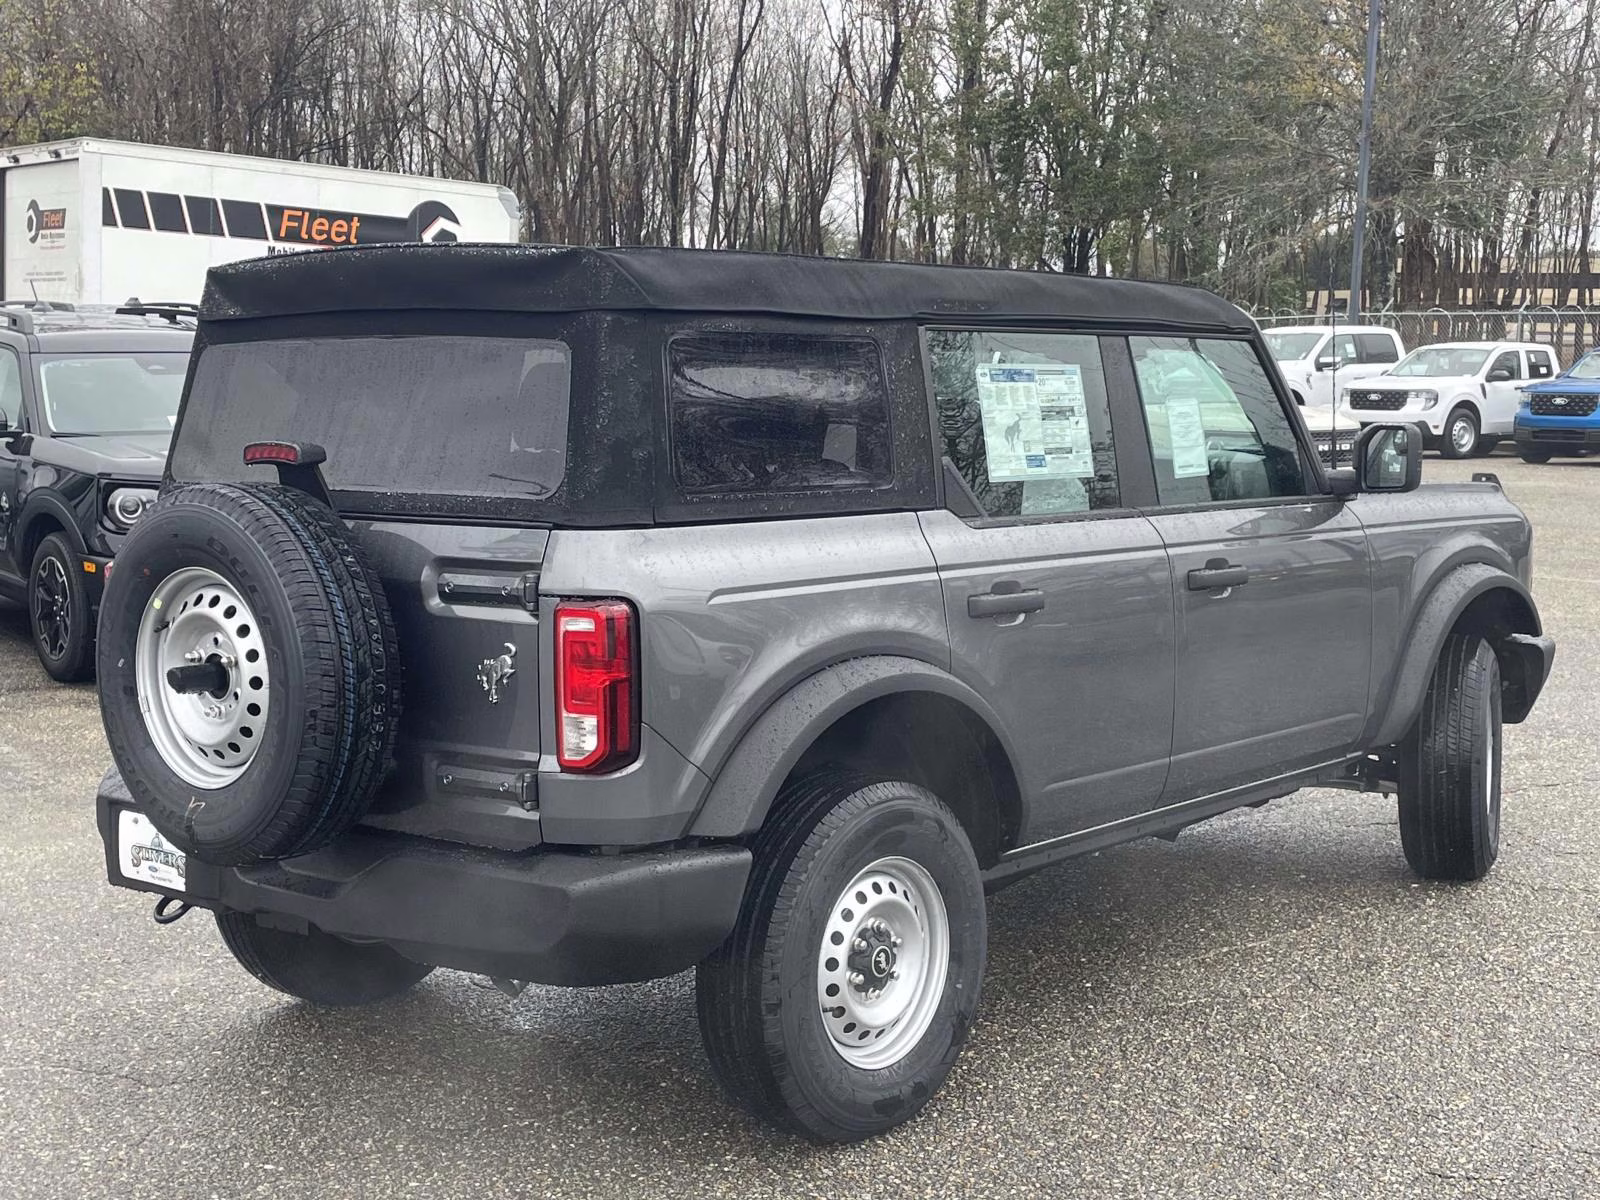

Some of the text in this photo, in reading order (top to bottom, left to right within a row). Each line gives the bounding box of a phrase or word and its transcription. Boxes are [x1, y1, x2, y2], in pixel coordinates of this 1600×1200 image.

[43, 211, 63, 227] Fleet
[279, 209, 361, 244] Fleet
[267, 246, 296, 257] Mobil
